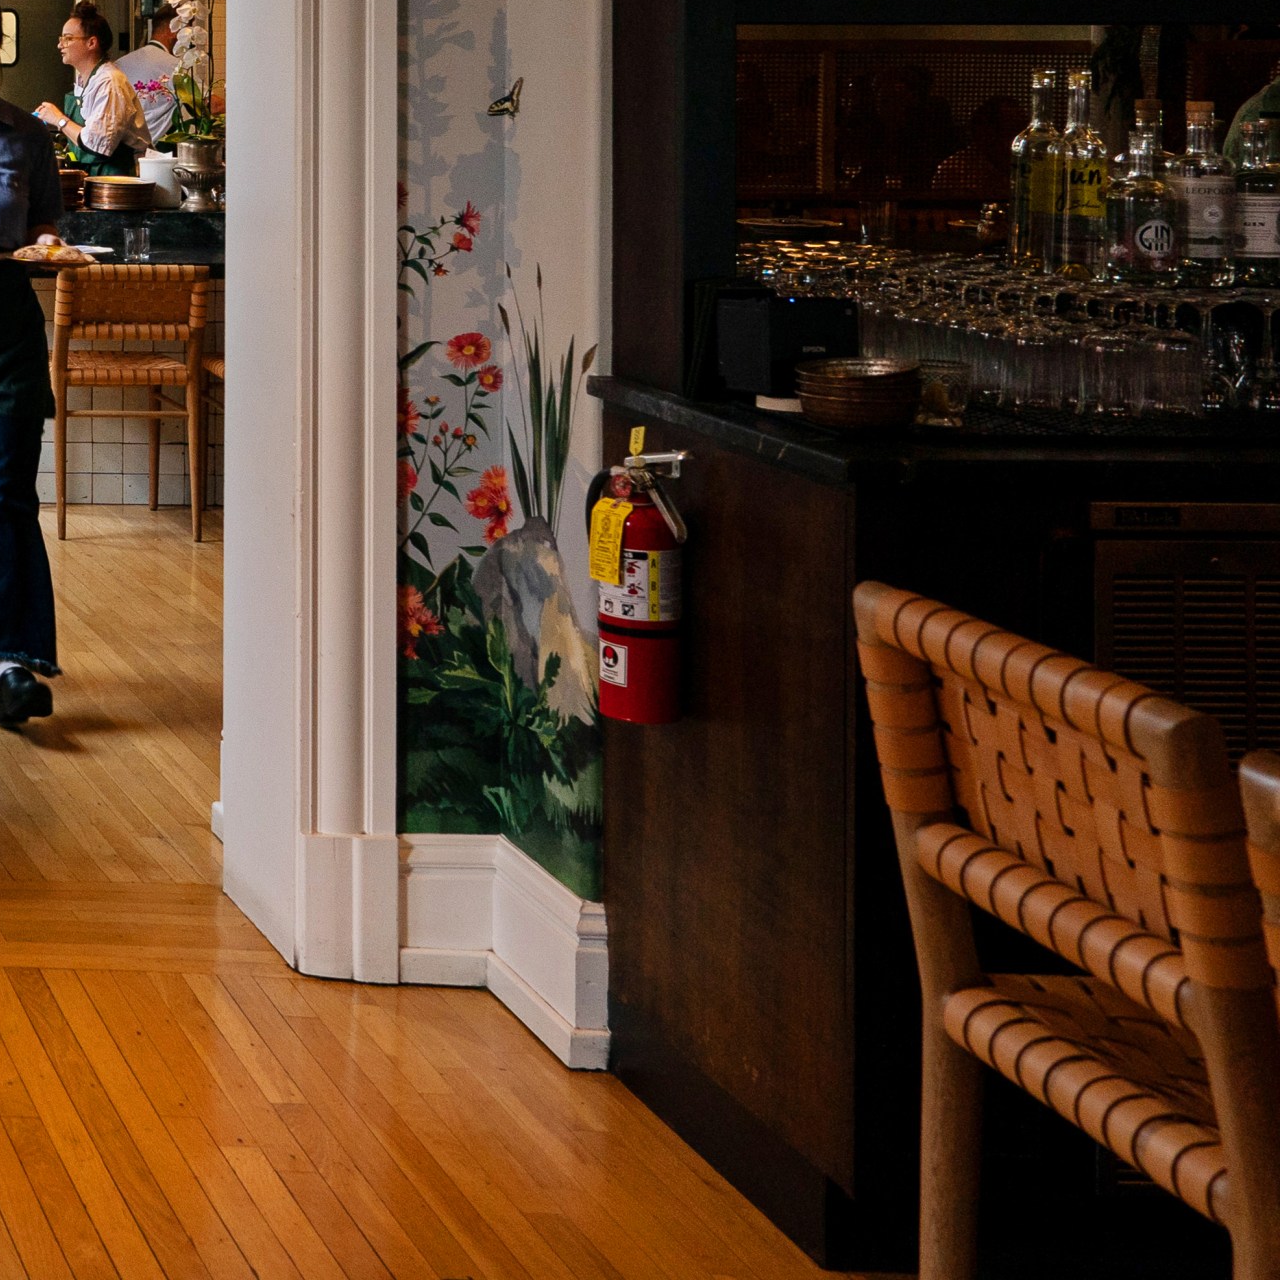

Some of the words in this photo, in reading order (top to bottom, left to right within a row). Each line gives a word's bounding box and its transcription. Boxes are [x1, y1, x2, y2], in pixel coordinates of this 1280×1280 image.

[651, 558, 657, 569] A
[651, 581, 657, 591] B
[651, 604, 657, 614] C
